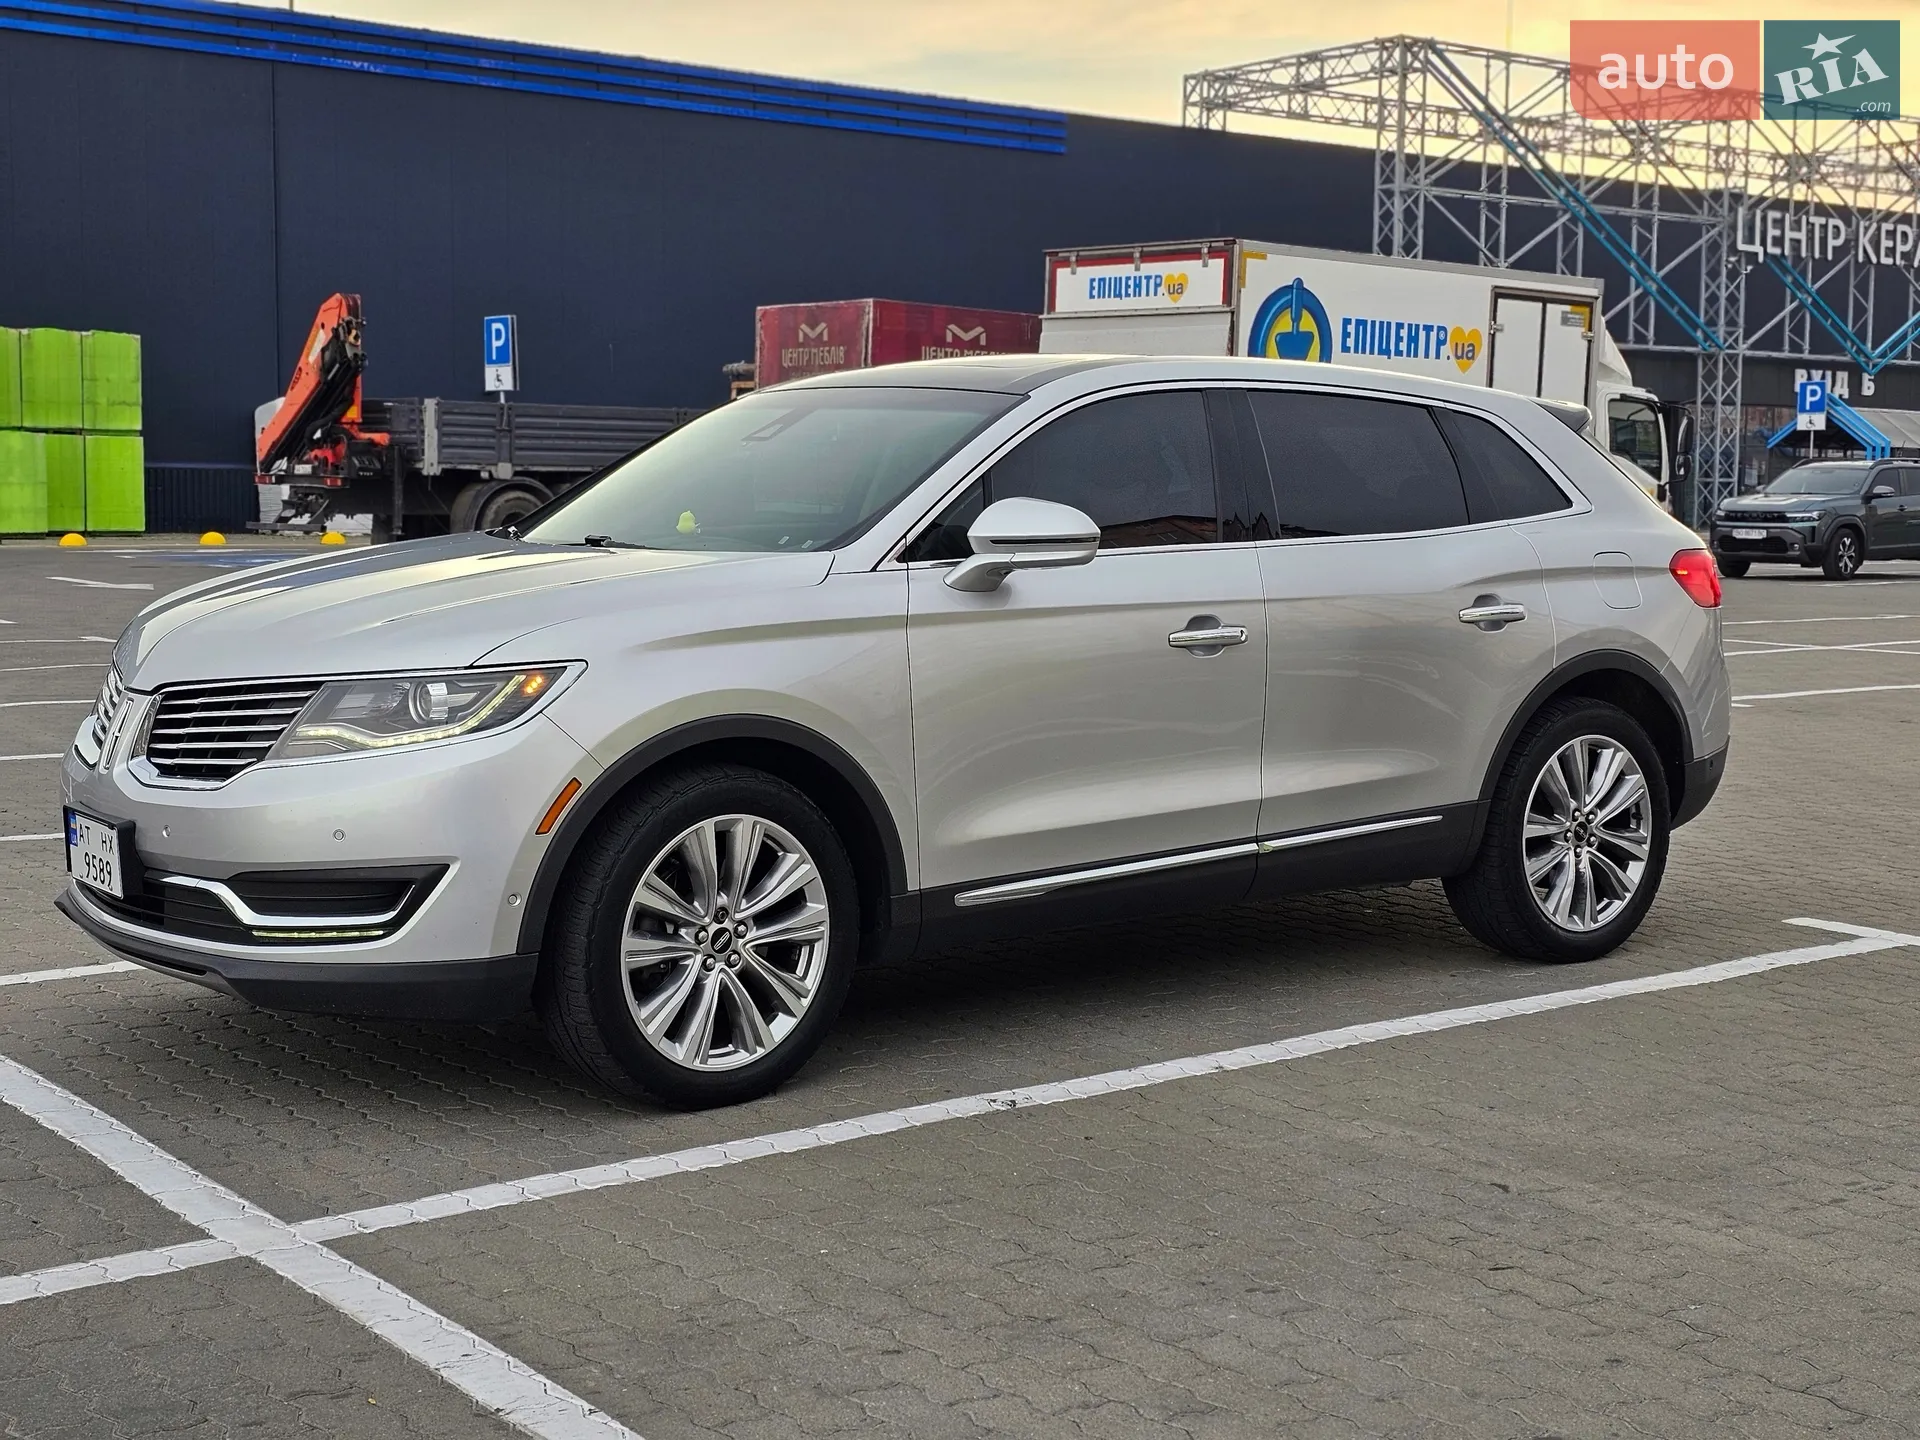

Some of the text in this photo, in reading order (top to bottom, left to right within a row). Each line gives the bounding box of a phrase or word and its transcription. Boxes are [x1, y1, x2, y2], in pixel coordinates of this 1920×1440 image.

[1736, 205, 1920, 268] ЦЕНТР КЕР
[491, 322, 506, 360] P
[781, 345, 845, 368] ЦЕНТР МЕБЛІВ
[1805, 384, 1822, 410] P
[1860, 372, 1875, 396] Б
[79, 823, 114, 855] AT HX
[84, 851, 112, 887] 9589
